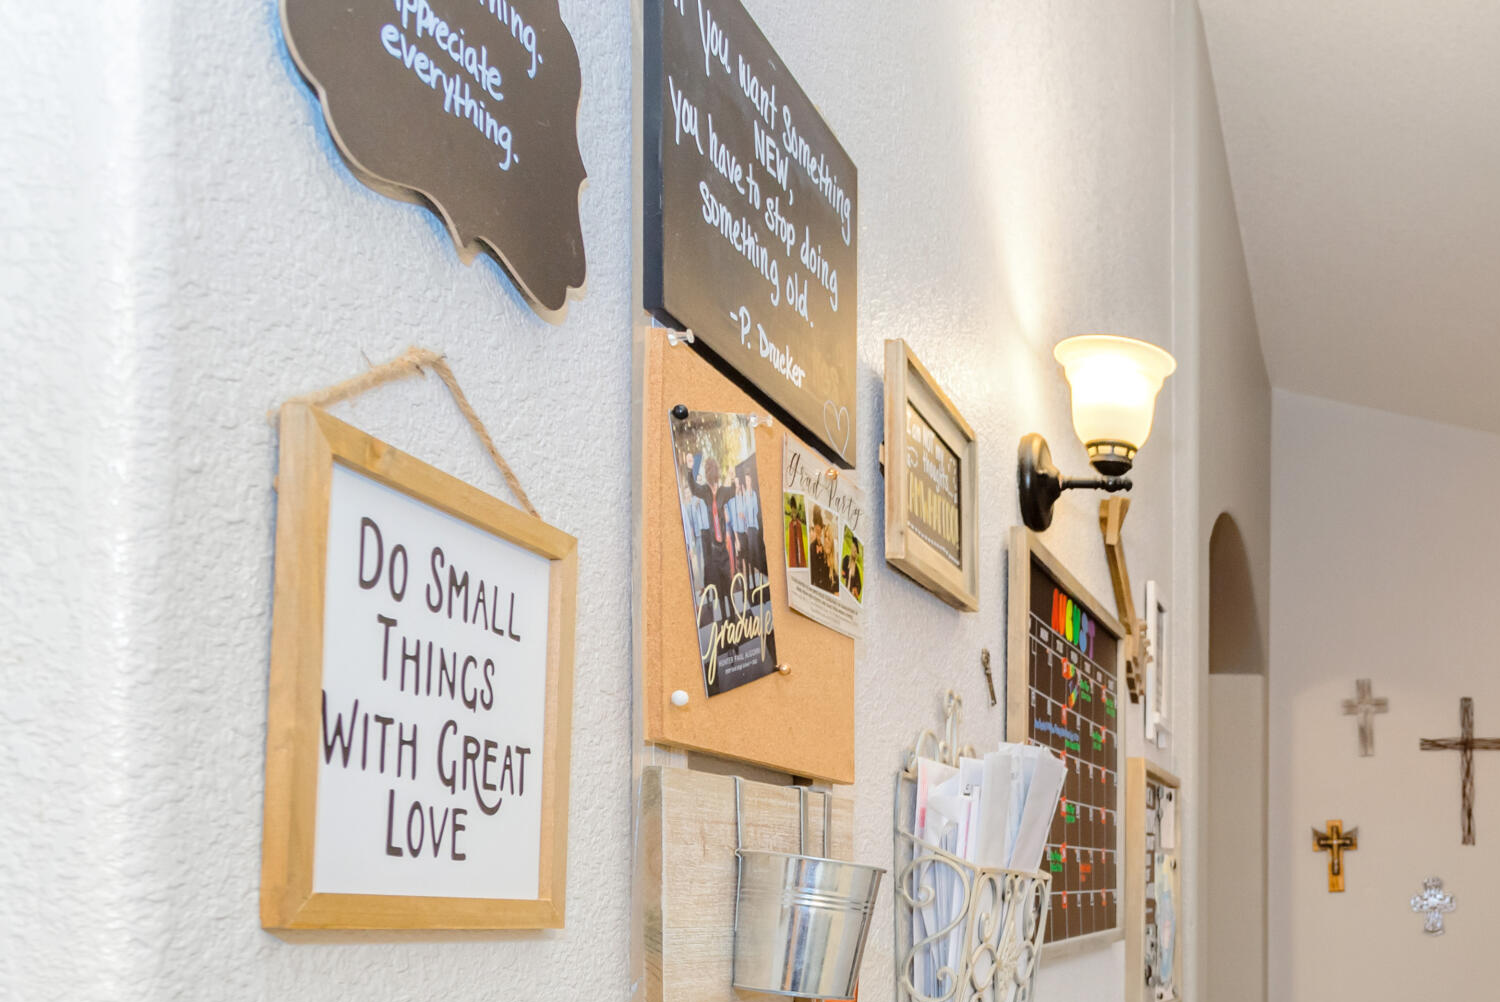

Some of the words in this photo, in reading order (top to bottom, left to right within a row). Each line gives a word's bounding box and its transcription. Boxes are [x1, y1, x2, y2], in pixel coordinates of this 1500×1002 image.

[393, 0, 504, 101] ppreciate
[380, 24, 520, 171] everything.
[738, 54, 777, 130] want
[753, 120, 794, 206] NEW,
[707, 113, 746, 195] have
[746, 163, 761, 210] to
[800, 225, 839, 313] doing
[785, 272, 815, 329] old.
[757, 323, 806, 388] Drucker
[385, 789, 468, 861] LOVE
